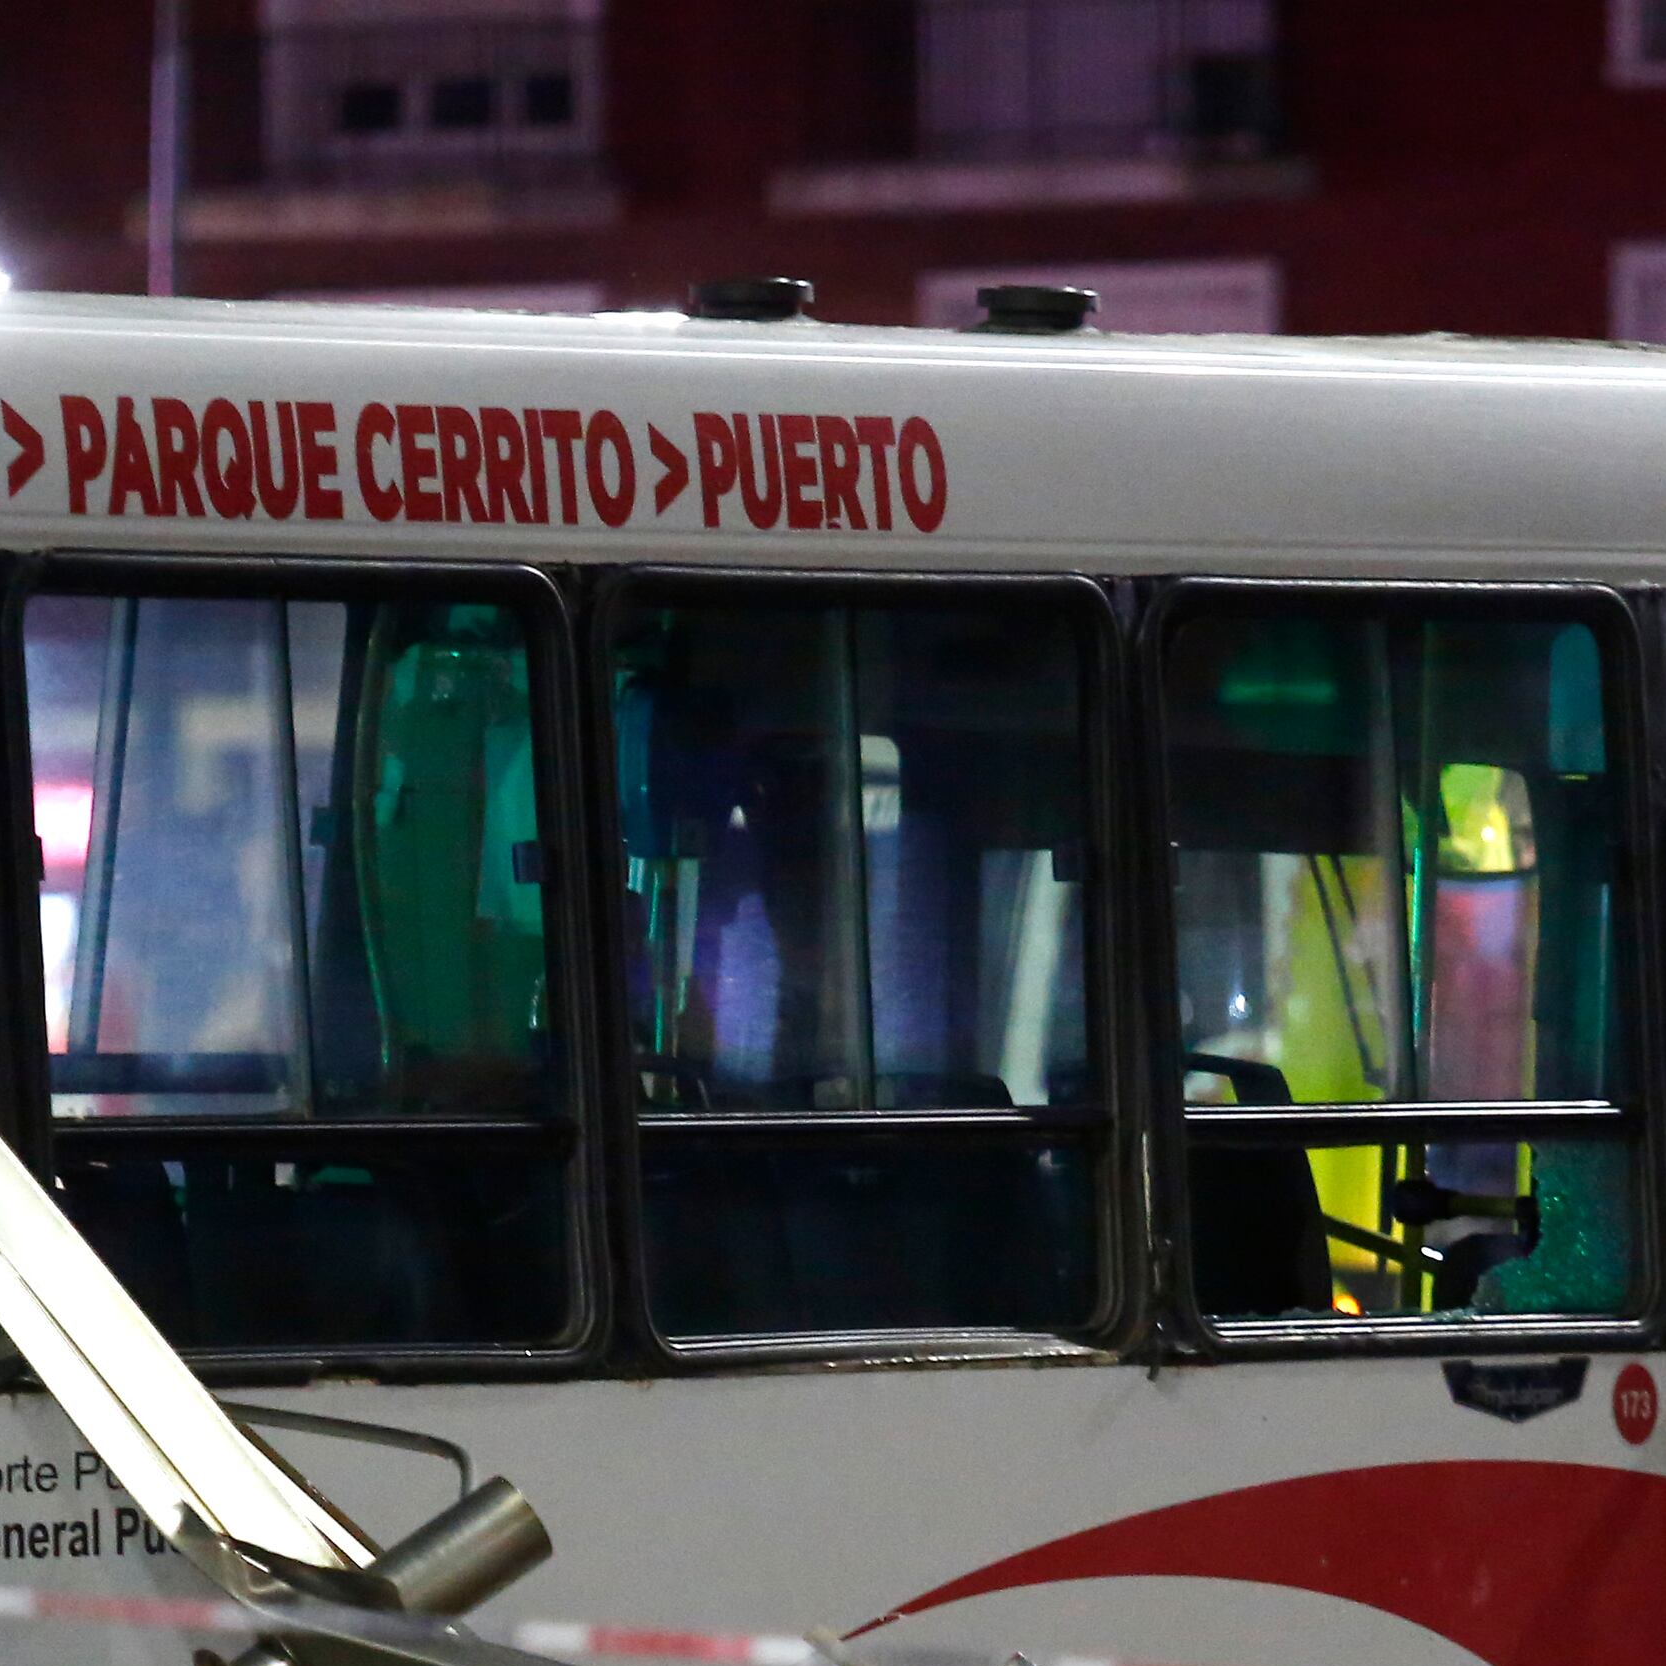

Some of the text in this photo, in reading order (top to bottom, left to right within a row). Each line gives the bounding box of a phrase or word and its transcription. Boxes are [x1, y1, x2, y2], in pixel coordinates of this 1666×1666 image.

[62, 397, 343, 518] PARQUE
[357, 404, 635, 527] CERRITO
[695, 413, 946, 531] PUERTO
[1620, 1389, 1652, 1420] 173
